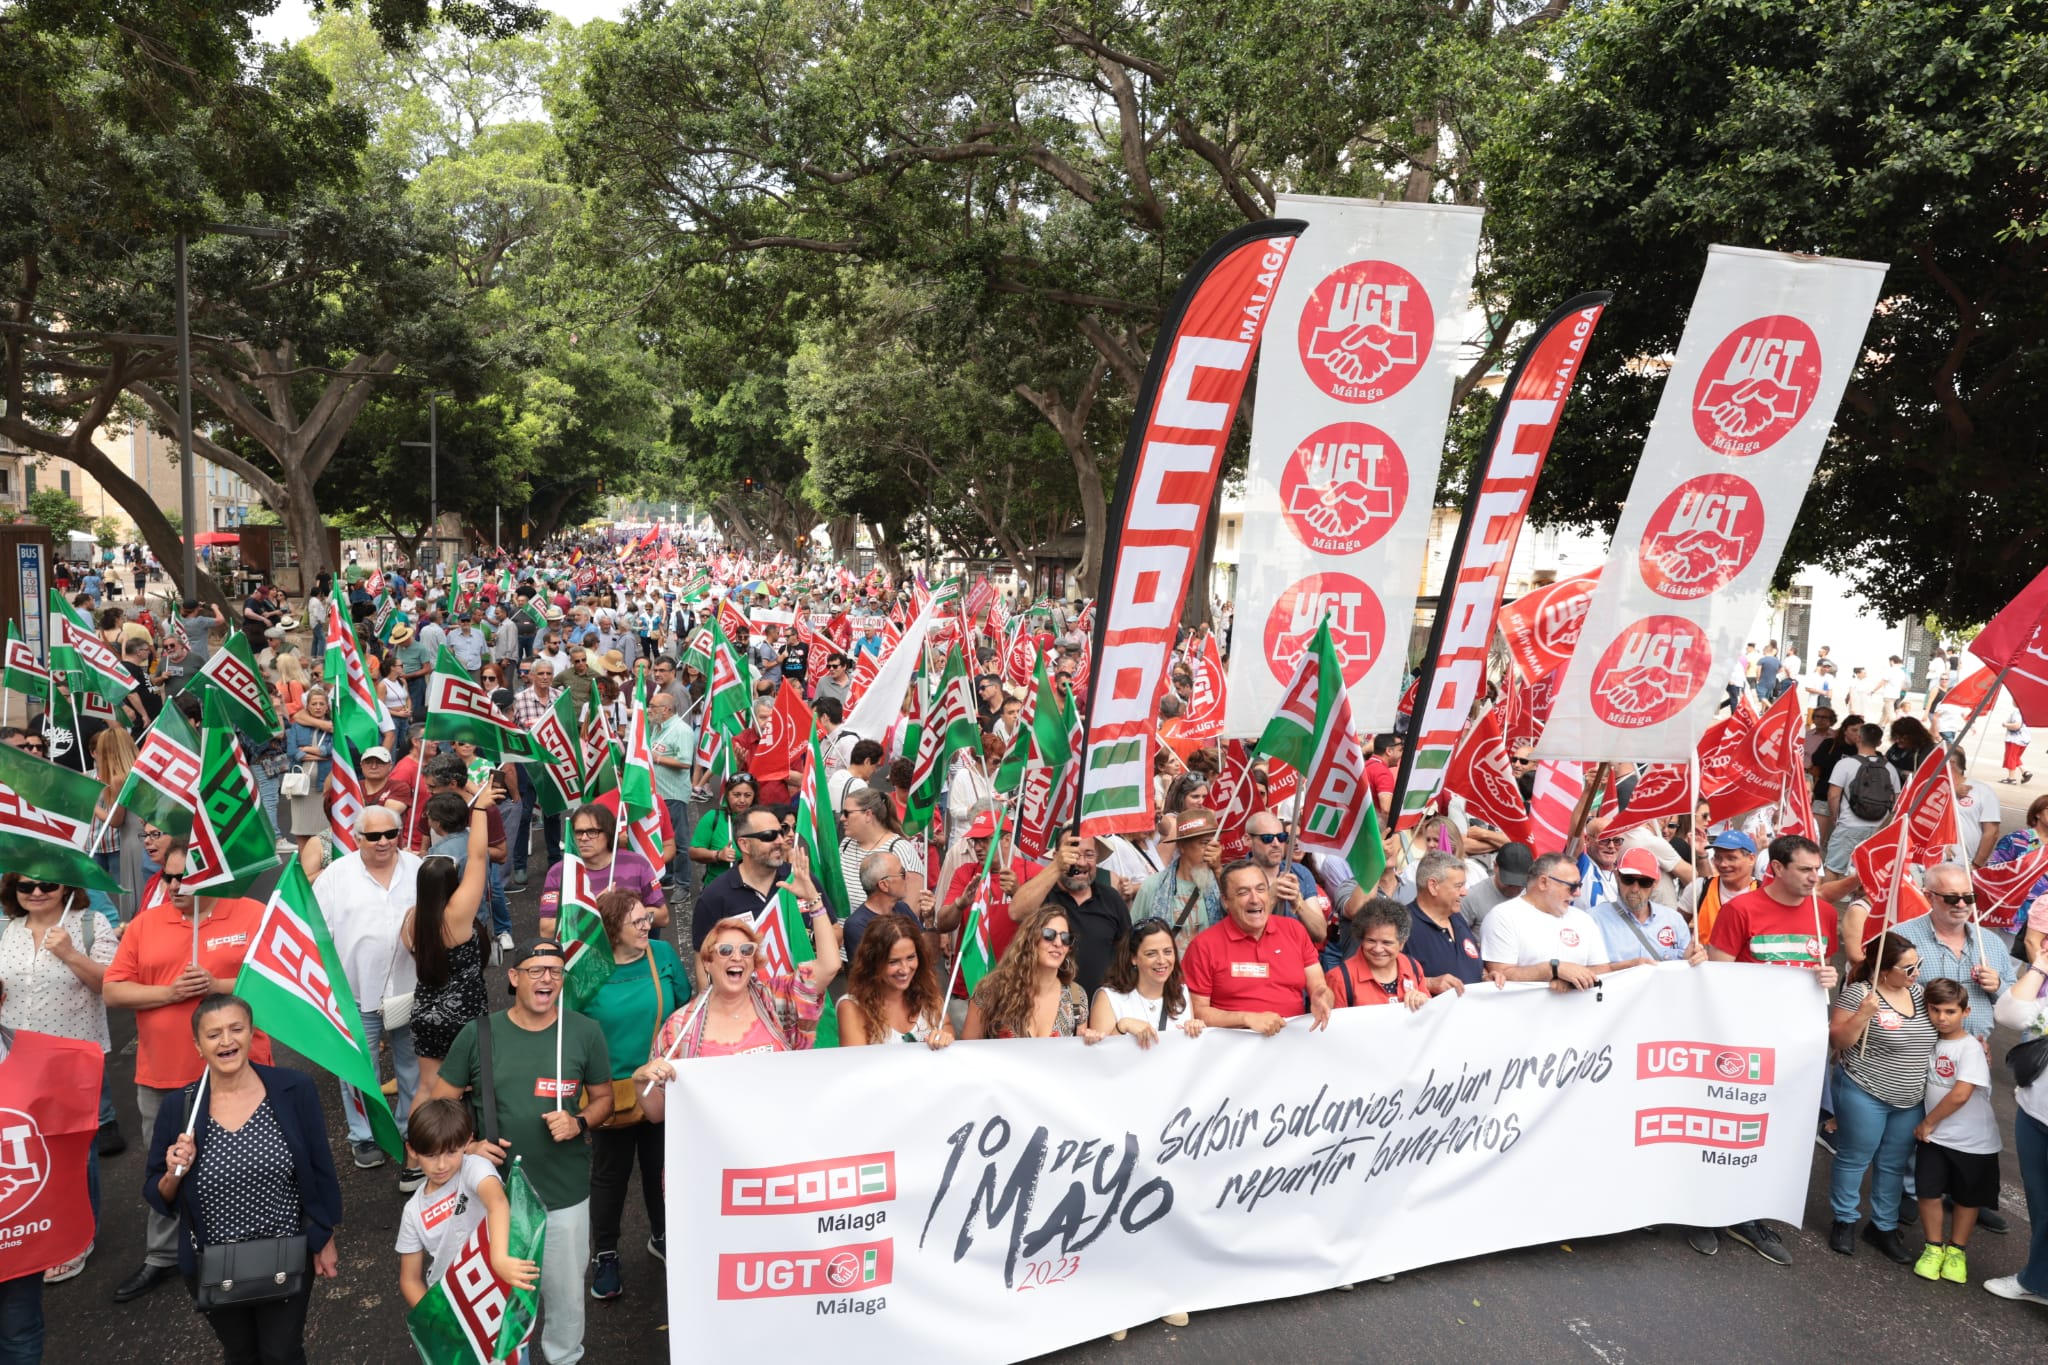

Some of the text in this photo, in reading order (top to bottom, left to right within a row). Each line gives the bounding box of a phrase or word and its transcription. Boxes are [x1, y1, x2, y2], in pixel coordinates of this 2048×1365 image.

[1239, 237, 1292, 342] MÁLAGA
[1329, 283, 1408, 330] UGT
[1725, 337, 1804, 386] UGT
[1332, 384, 1384, 400] Málaga
[1712, 435, 1760, 453] Málaga
[1308, 443, 1384, 488] UGT
[1668, 493, 1747, 537] UGT
[20, 547, 37, 559] BUS
[1312, 536, 1361, 552] Málaga
[1657, 581, 1704, 598] Málaga
[1290, 592, 1361, 632] UGT
[1618, 632, 1693, 673] UGT
[1607, 712, 1652, 726] Málaga
[1647, 1047, 1711, 1073] UGT
[1157, 1097, 1258, 1164] Subir
[1409, 1062, 1492, 1120] bajar
[1494, 1044, 1612, 1104] precios
[1707, 1085, 1767, 1104] Málaga
[1640, 1113, 1738, 1142] CCOO
[1050, 1138, 1101, 1174] DE
[1216, 1113, 1521, 1212] repartir beneficios
[1702, 1150, 1758, 1168] Málaga
[732, 1166, 857, 1206] CCOO
[817, 1210, 886, 1233] Málaga
[954, 1126, 1174, 1288] MAYO
[736, 1259, 821, 1293] UGT
[1017, 1256, 1080, 1292] 2023
[816, 1296, 886, 1316] Málaga
